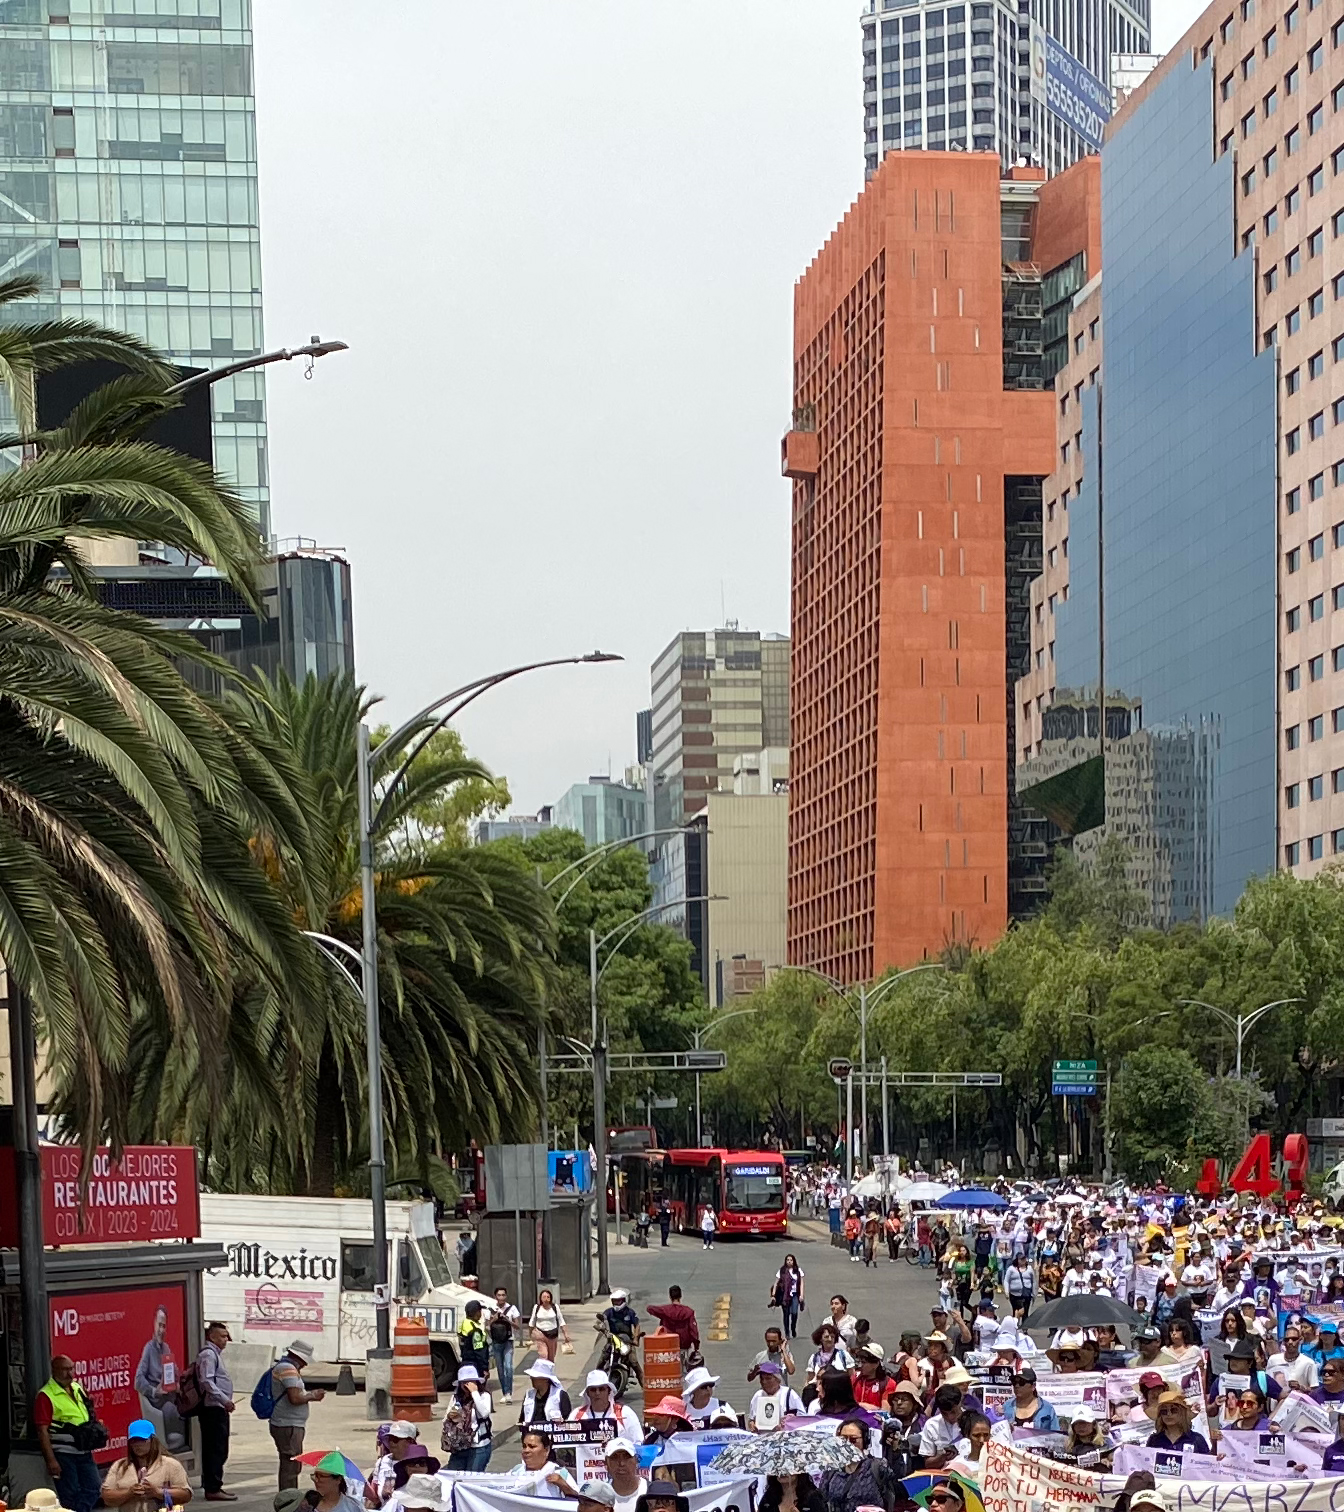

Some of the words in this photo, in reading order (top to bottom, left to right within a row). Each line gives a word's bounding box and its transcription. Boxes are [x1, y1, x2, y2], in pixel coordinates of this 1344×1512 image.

[52, 1154, 79, 1178] LOS
[108, 1211, 138, 1234] 2023
[150, 1209, 178, 1232] 2024
[54, 1309, 79, 1336] MB
[90, 1354, 131, 1371] MEJORES
[986, 1456, 1011, 1474] POR
[1020, 1464, 1041, 1479] TU
[984, 1475, 1008, 1492] POR
[1017, 1478, 1037, 1496] TU
[1046, 1487, 1100, 1503] HERMANA
